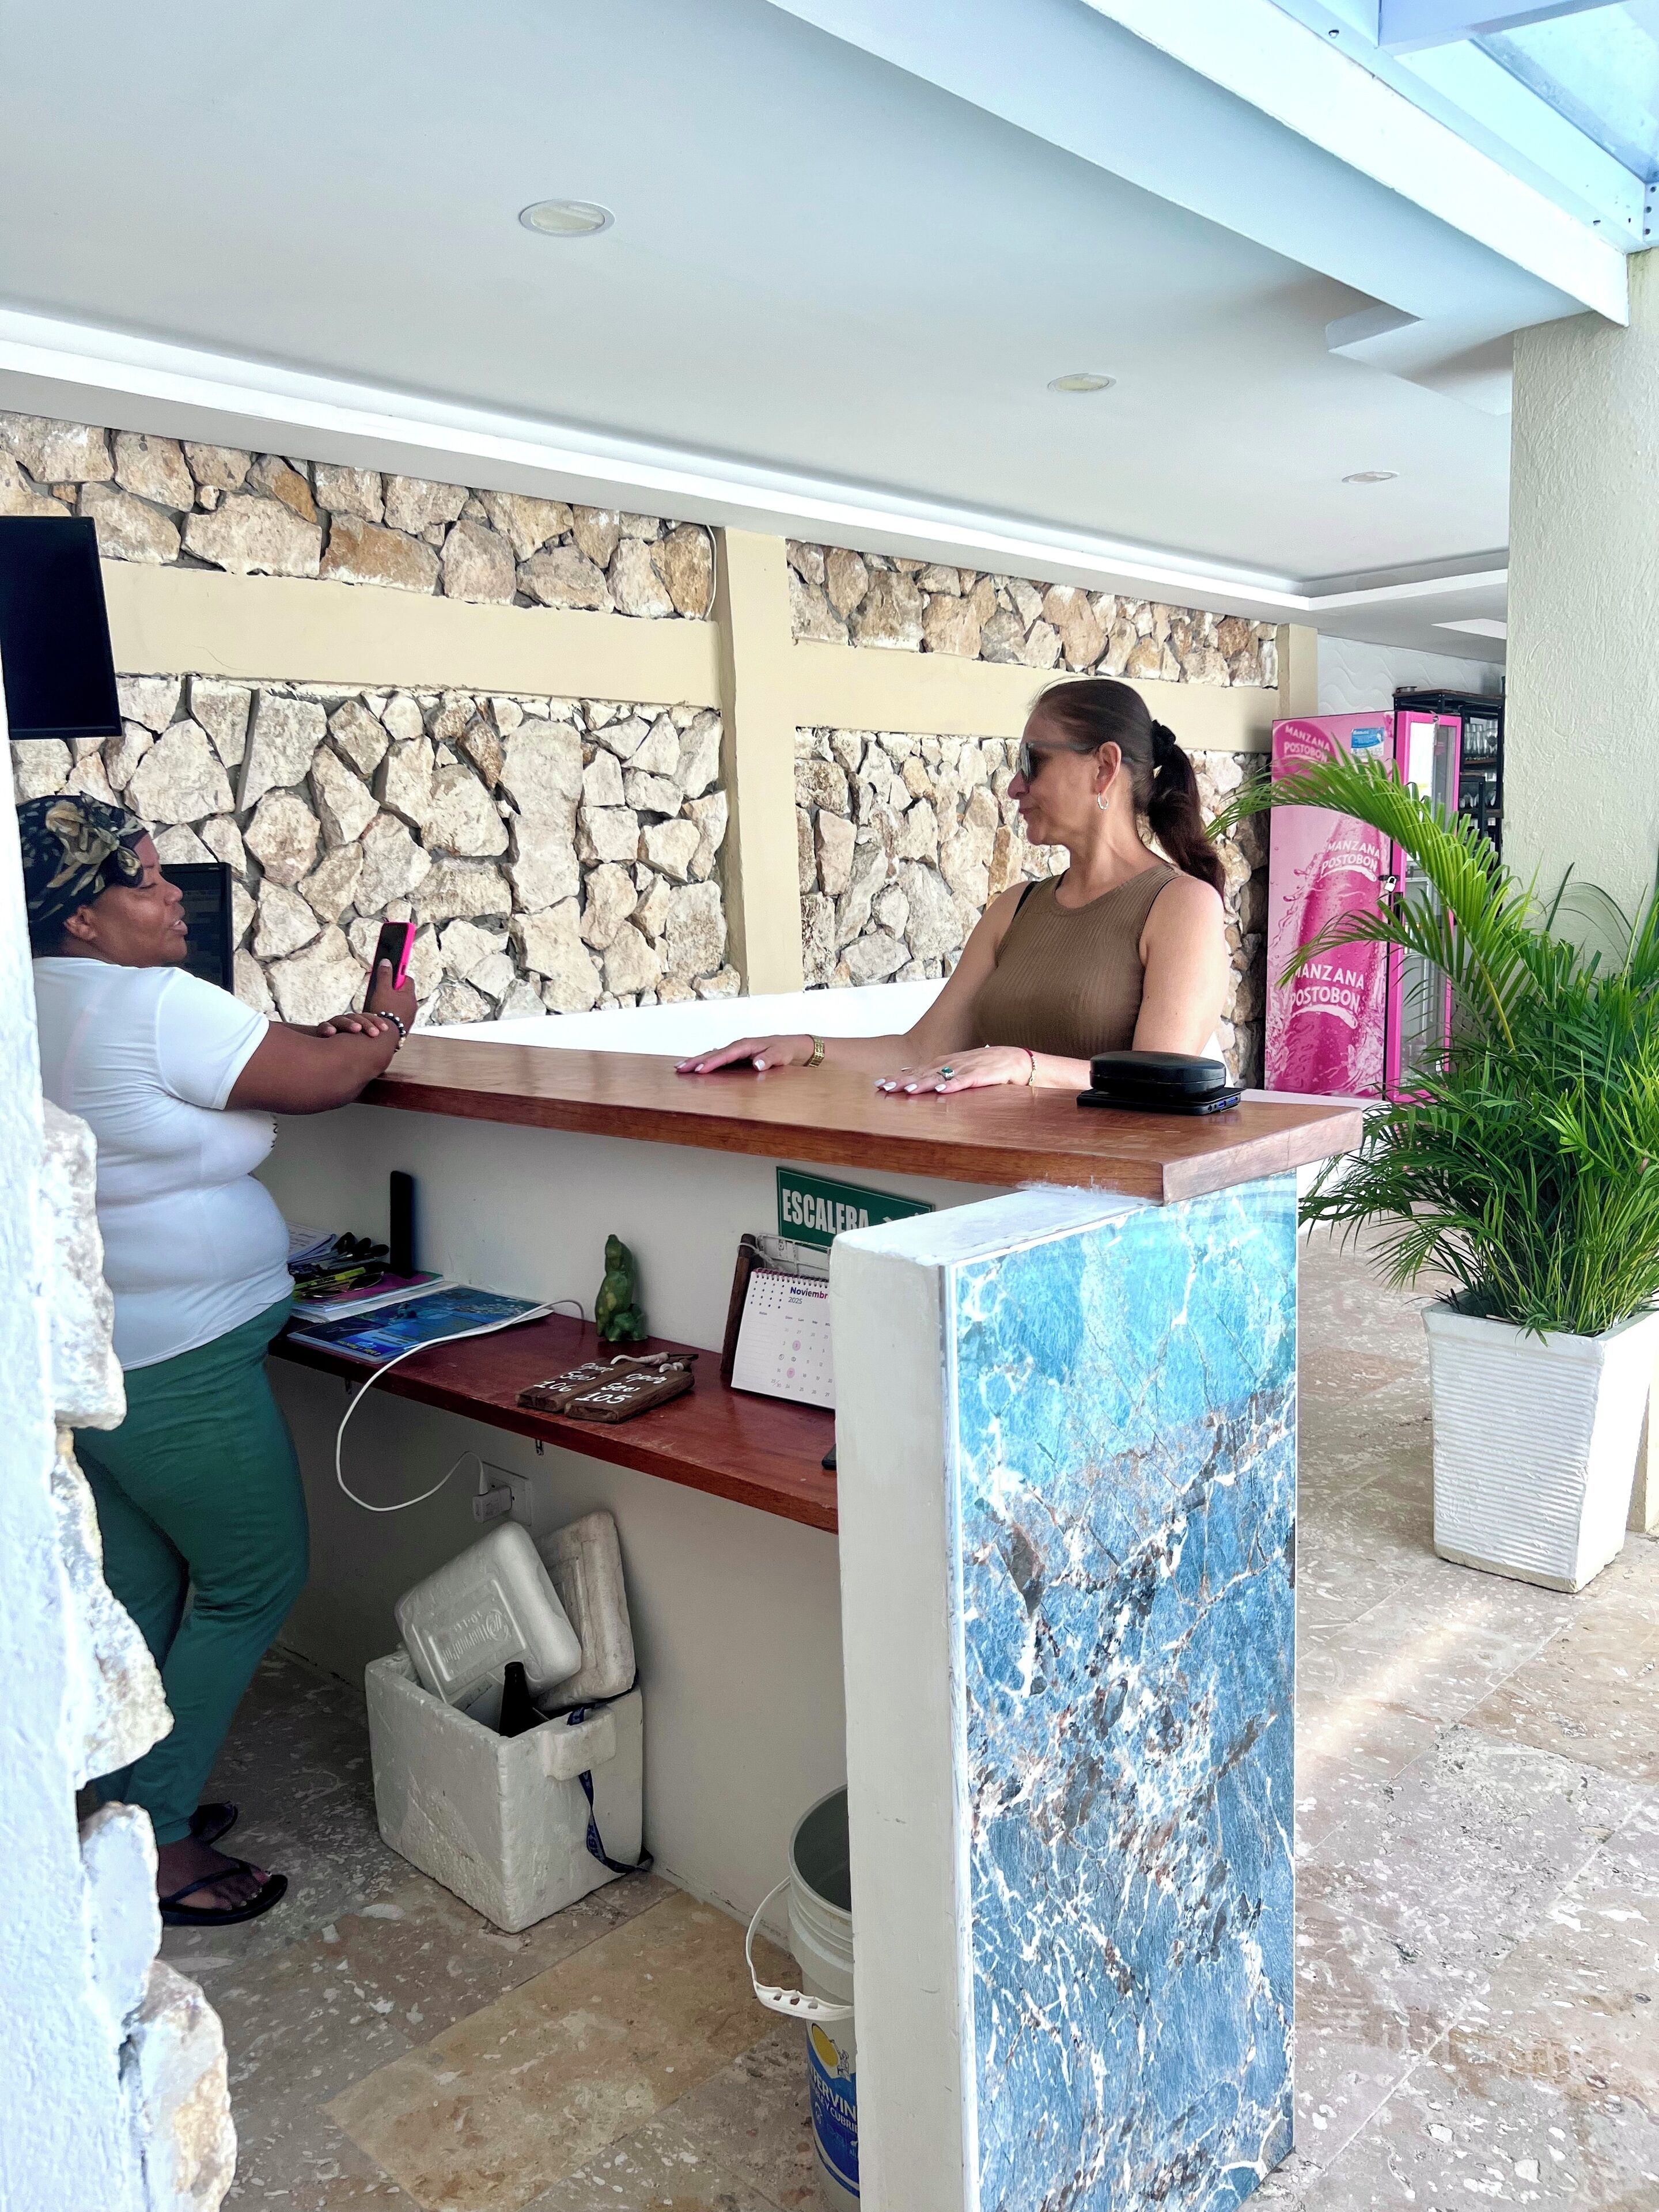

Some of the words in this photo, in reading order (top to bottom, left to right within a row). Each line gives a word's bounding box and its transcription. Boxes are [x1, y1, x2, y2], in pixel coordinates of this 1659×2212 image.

[1285, 725, 1330, 751] MANZANA
[1283, 741, 1328, 762] POSTOBON
[1327, 840, 1380, 859] MANZANA
[1320, 854, 1378, 874] POSTOBON
[1290, 986, 1361, 1014] POSTOBON
[782, 1188, 869, 1234] ESCALERA
[790, 1286, 828, 1300] Noviembr
[533, 1380, 577, 1392] 106
[574, 1392, 633, 1404] 105
